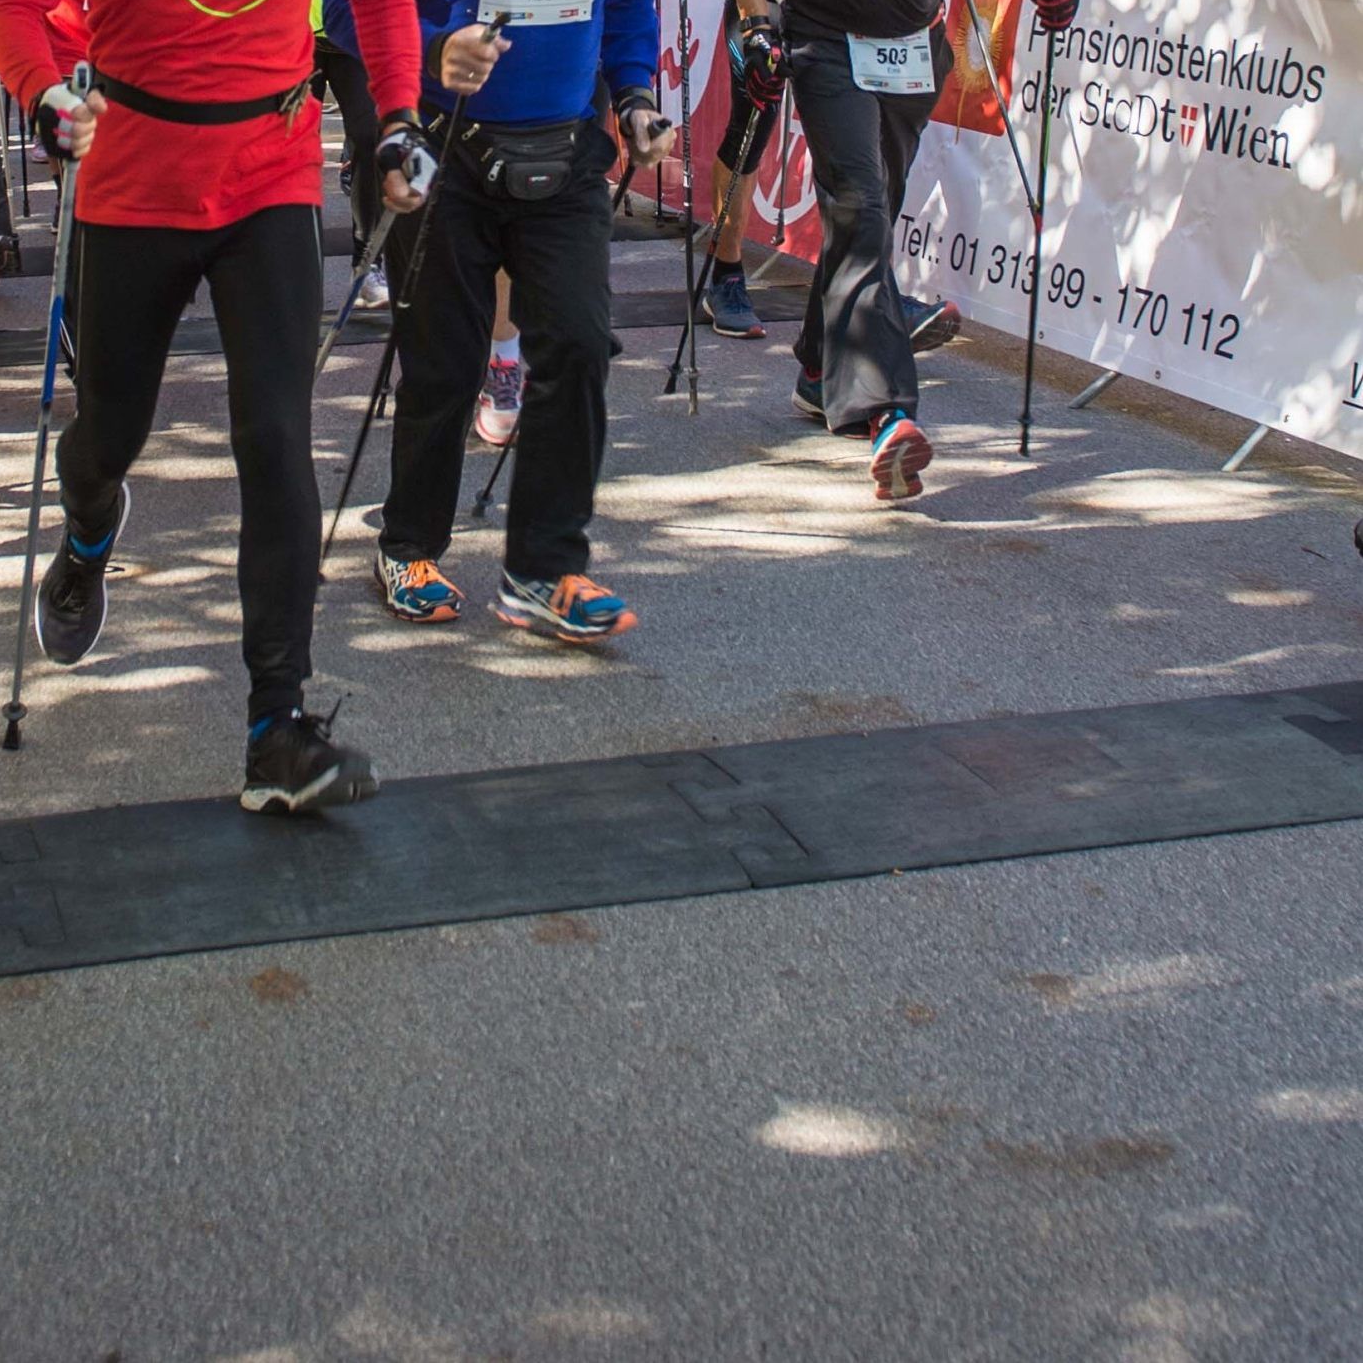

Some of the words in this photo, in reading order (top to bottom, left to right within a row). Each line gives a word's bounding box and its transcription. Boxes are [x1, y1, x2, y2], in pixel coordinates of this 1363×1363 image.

[877, 47, 908, 65] 503
[1079, 81, 1176, 143] StaDt
[1203, 102, 1292, 169] Wien
[900, 214, 943, 263] Tel.:
[950, 234, 978, 276] 01
[988, 245, 1037, 294] 313
[1048, 263, 1086, 309] 99
[1118, 284, 1169, 336] 170
[1182, 303, 1241, 360] 112
